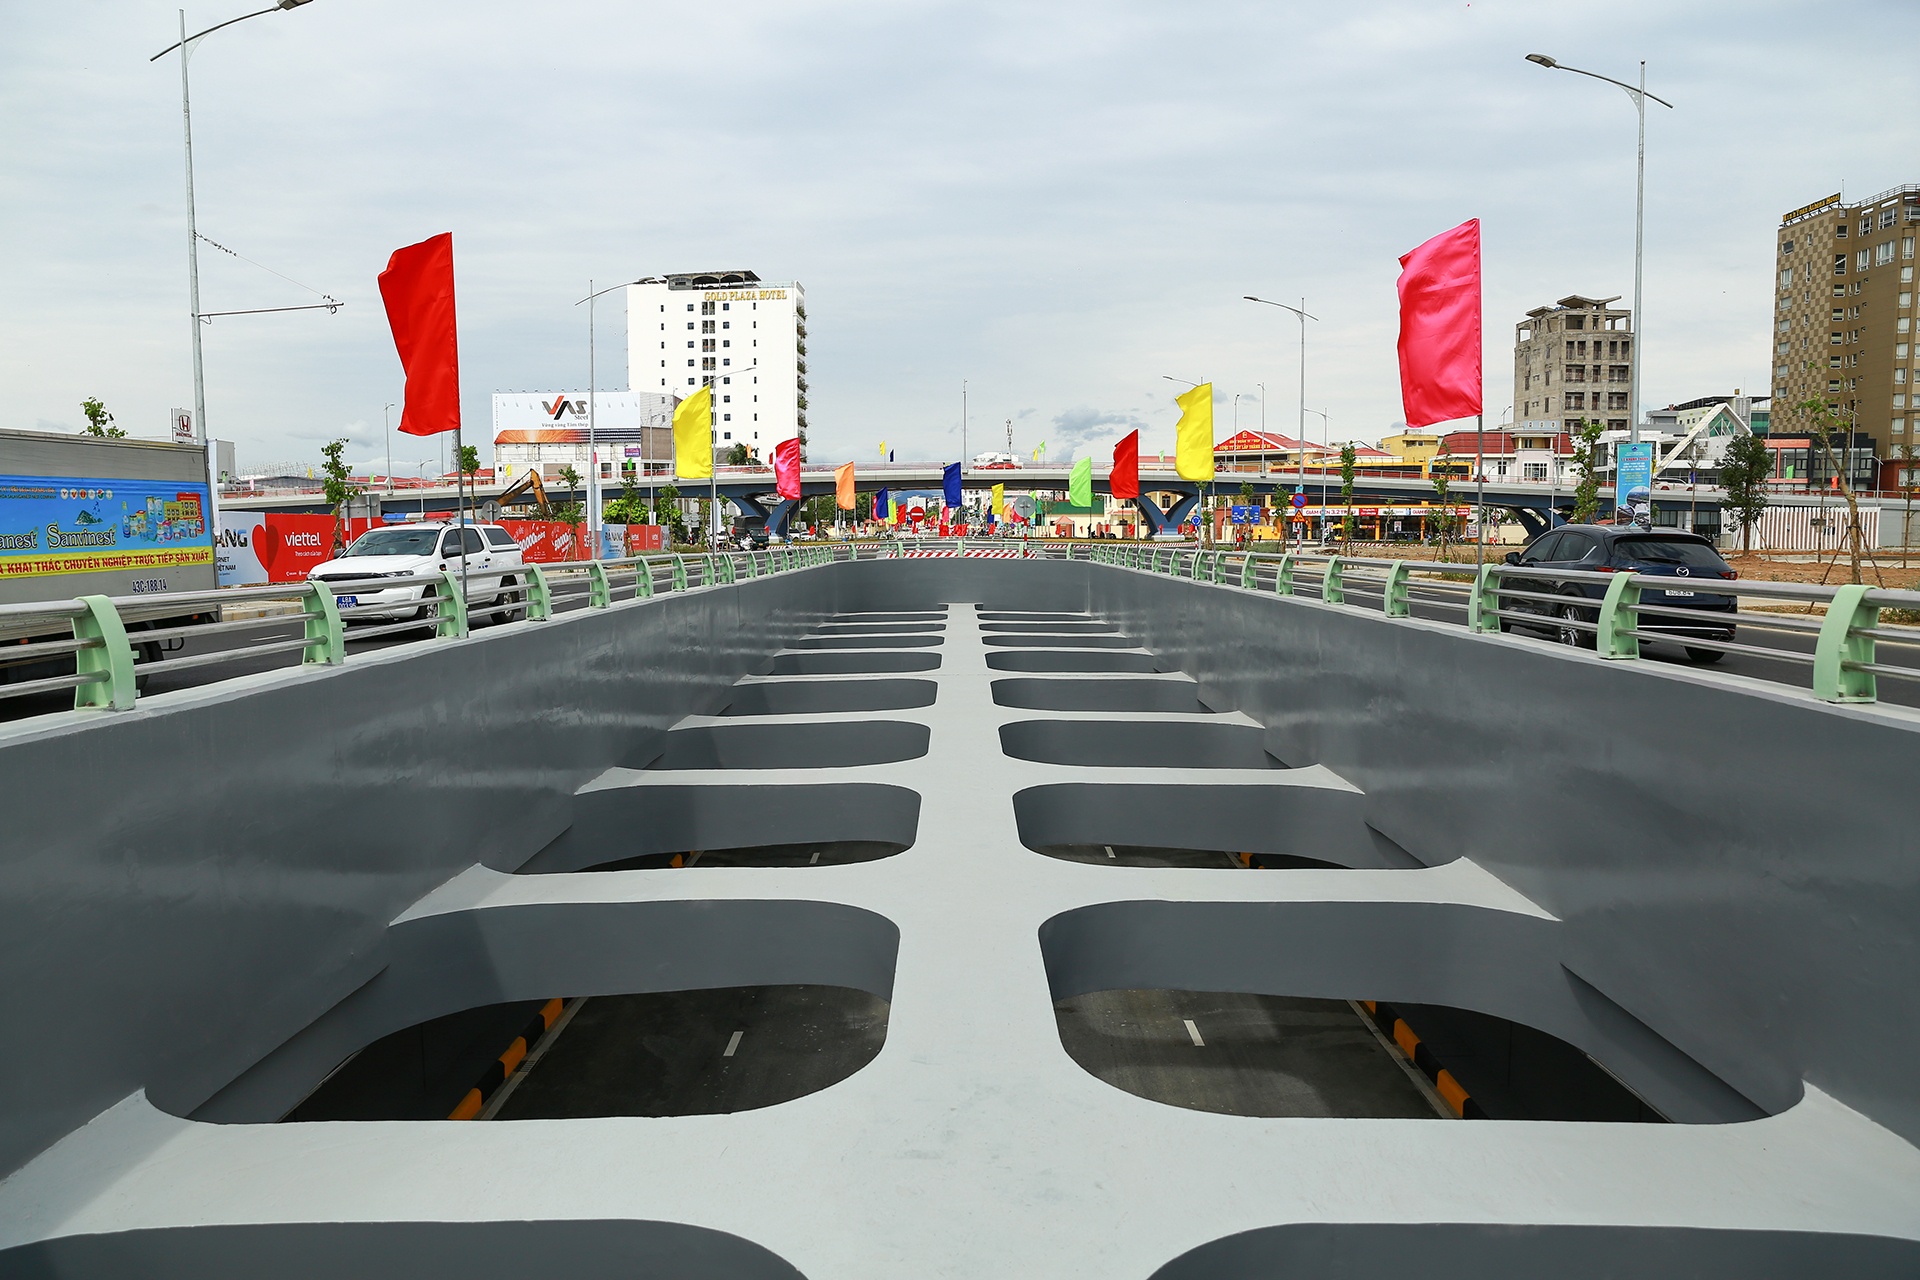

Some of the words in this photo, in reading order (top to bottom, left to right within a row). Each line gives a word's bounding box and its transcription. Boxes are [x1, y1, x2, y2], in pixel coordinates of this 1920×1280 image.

[704, 291, 728, 301] GOLD
[729, 290, 757, 301] PLAZA
[759, 289, 787, 300] HOTEL
[541, 395, 588, 421] VAS
[46, 523, 115, 549] Sanvinest
[284, 531, 321, 547] viettel
[7, 562, 32, 573] KHAI
[35, 558, 61, 572] THÁC
[64, 556, 100, 570] CHUYÊN
[102, 554, 132, 568] NGHIỆP
